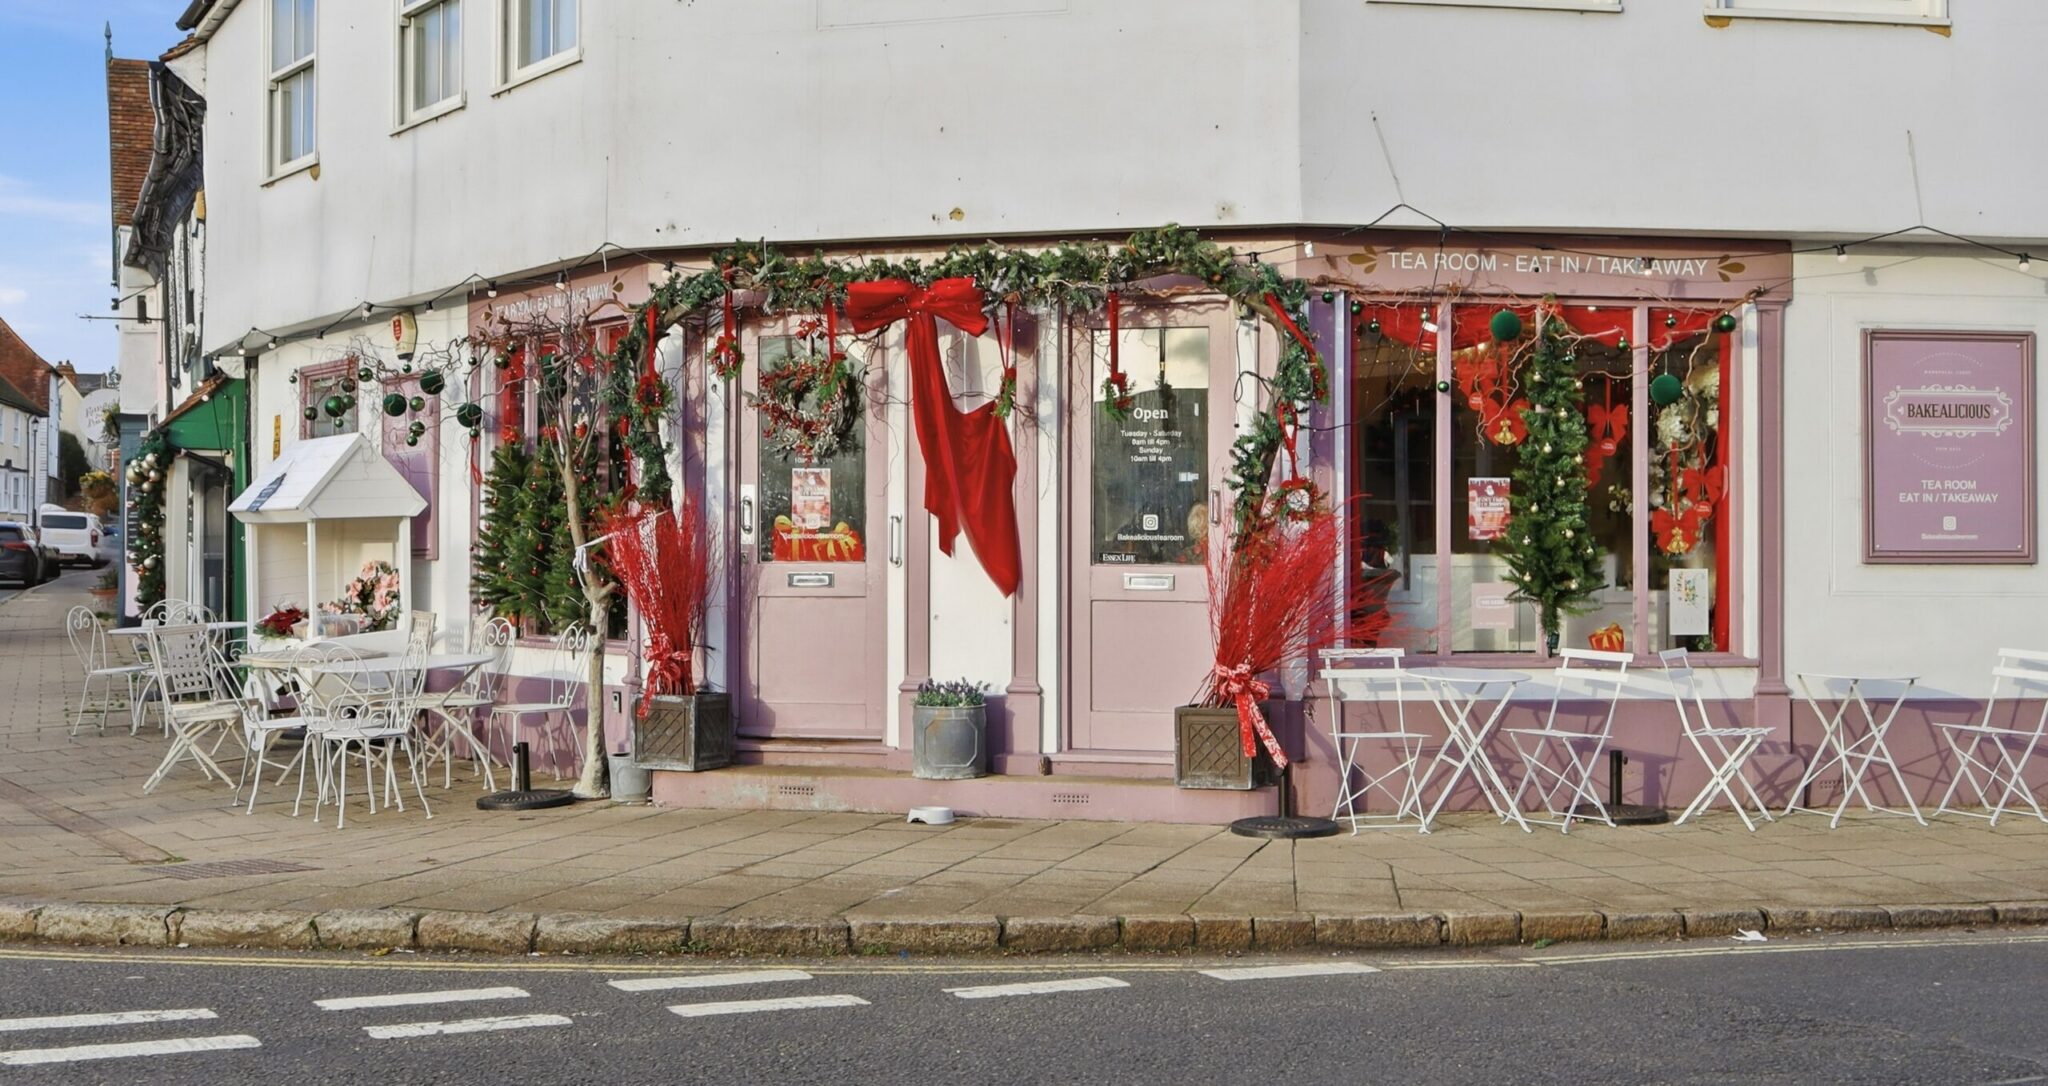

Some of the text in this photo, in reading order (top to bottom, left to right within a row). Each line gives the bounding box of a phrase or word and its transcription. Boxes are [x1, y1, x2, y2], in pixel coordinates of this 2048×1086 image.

[1387, 252, 1428, 269] TEA
[1434, 253, 1497, 271] ROOM
[1515, 255, 1555, 273] EAT
[1561, 256, 1580, 273] IN
[1585, 256, 1593, 273] /
[537, 295, 552, 312] EAT
[1133, 407, 1169, 422] Open
[1907, 403, 1991, 419] BAKEALICIOUS
[1120, 430, 1148, 438] Tuesday
[1153, 430, 1182, 438] Saturday
[1156, 438, 1171, 447] 4pm
[1139, 446, 1164, 455] Sunday
[1130, 454, 1148, 462] 10am
[1158, 455, 1172, 463] 4pm
[1921, 480, 1977, 490] TEA ROOM
[1899, 493, 1920, 503] EAT
[1922, 493, 1933, 503] IN
[1942, 493, 1999, 503] TAKEAWAY
[1117, 533, 1184, 541] Bakealicioustearoom
